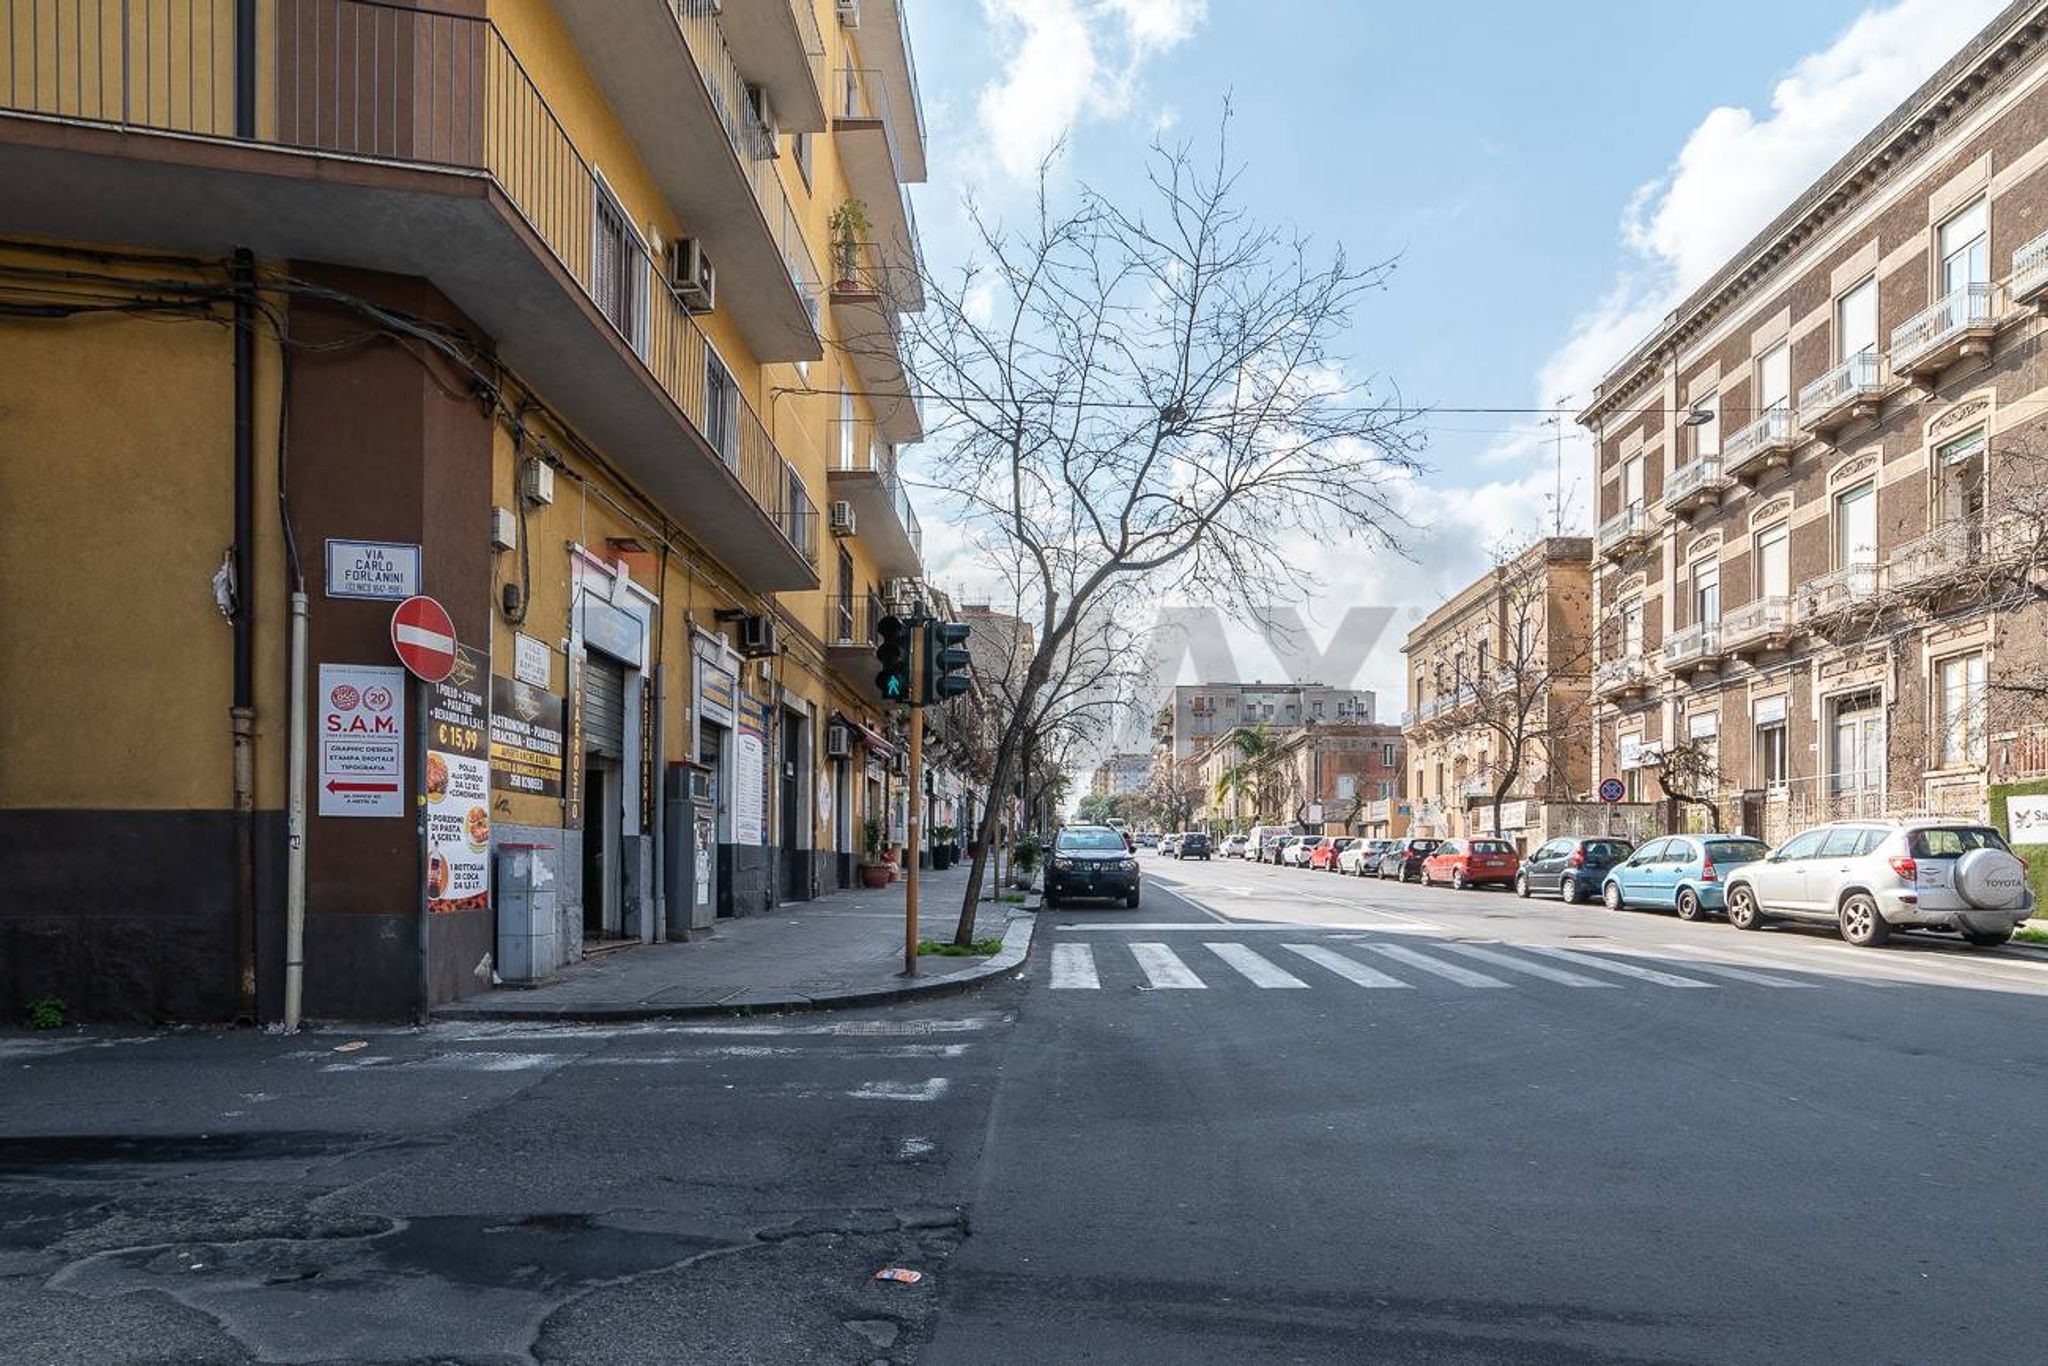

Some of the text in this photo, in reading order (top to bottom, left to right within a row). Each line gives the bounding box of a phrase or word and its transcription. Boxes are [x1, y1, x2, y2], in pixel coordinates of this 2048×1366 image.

[365, 549, 384, 560] VIA
[355, 559, 393, 572] CARLO
[344, 570, 403, 583] FORLANINI
[440, 683, 458, 699] POLLO
[370, 693, 386, 705] 20
[327, 713, 399, 734] S.A.M.
[439, 724, 478, 752] € 15,99
[331, 745, 364, 753] GRAPHIC
[459, 764, 477, 773] POLLO
[464, 774, 483, 783] SPIEDO
[433, 814, 464, 824] PORZIONI
[431, 823, 461, 833] DI PASTA
[438, 833, 461, 842] SCELTA
[454, 863, 485, 872] BOTTIGLIA
[462, 872, 479, 881] COCA
[1985, 879, 2022, 887] TOYOTA
